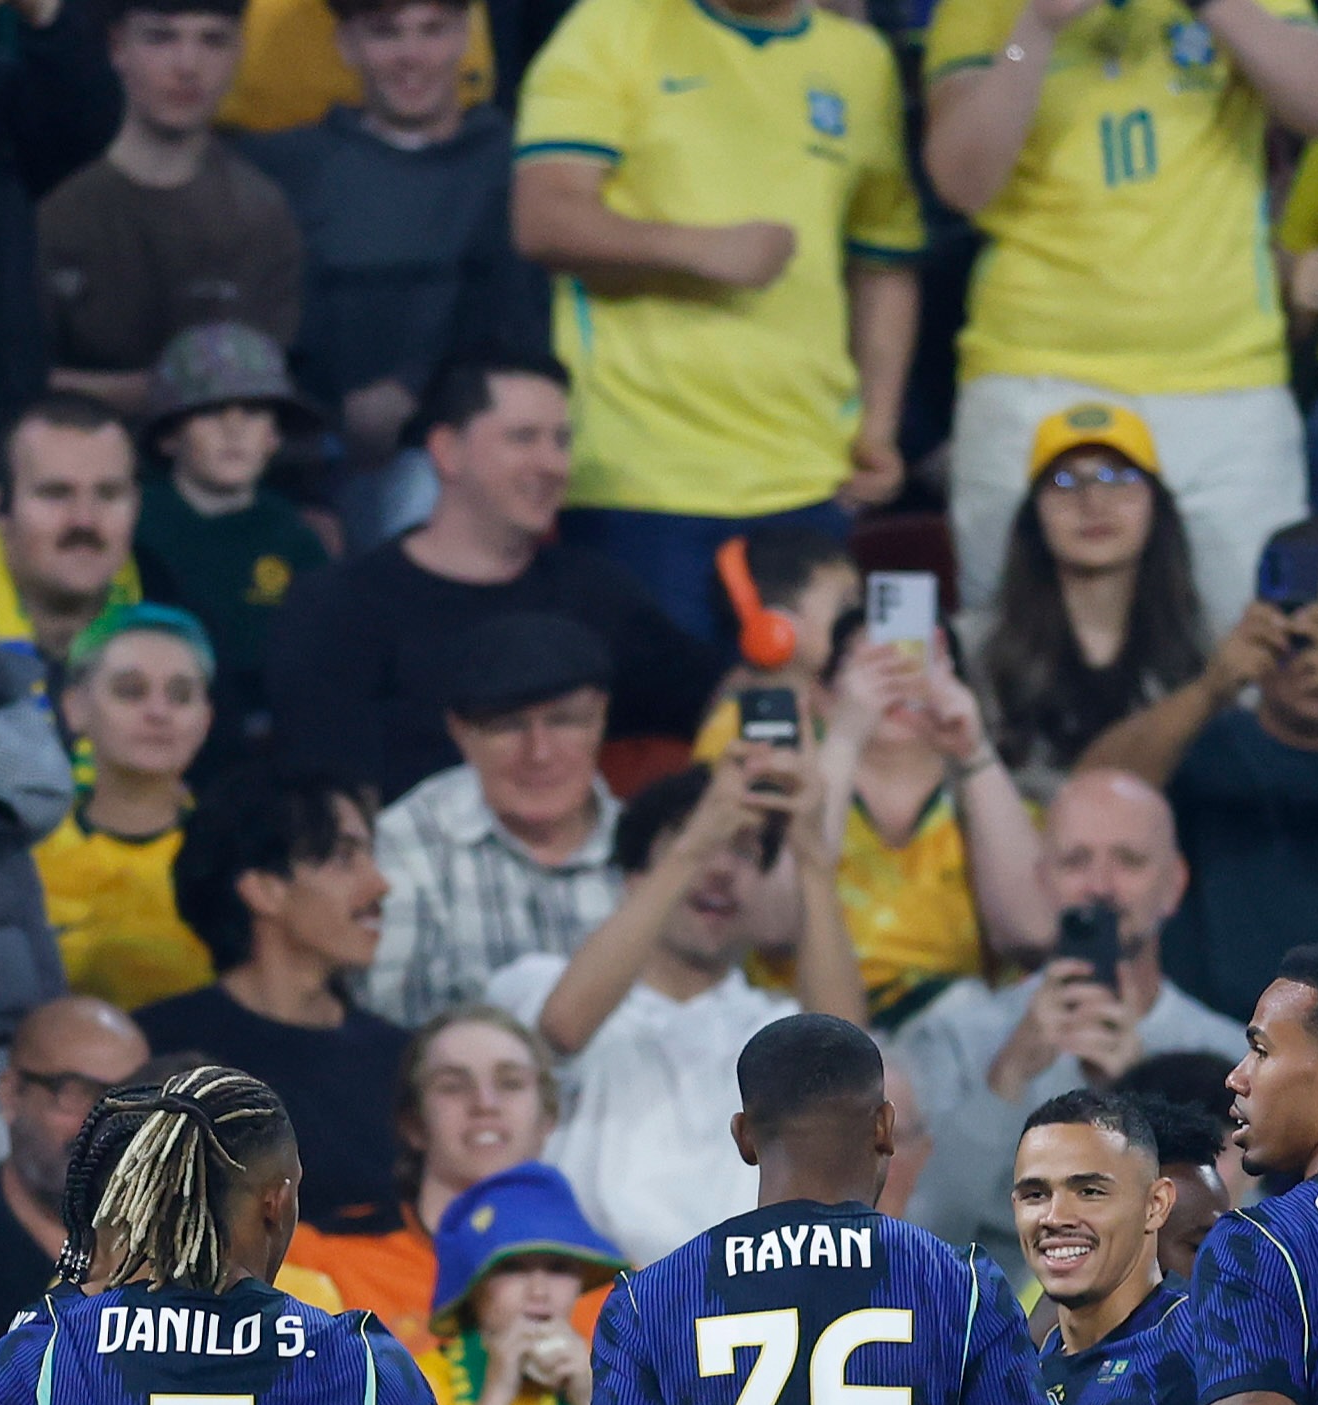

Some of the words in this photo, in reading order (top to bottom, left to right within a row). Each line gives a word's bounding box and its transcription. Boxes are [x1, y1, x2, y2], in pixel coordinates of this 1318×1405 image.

[1099, 108, 1158, 187] 10
[724, 1223, 873, 1277] RAYAN
[97, 1305, 262, 1356] DANILO
[277, 1313, 317, 1358] S.
